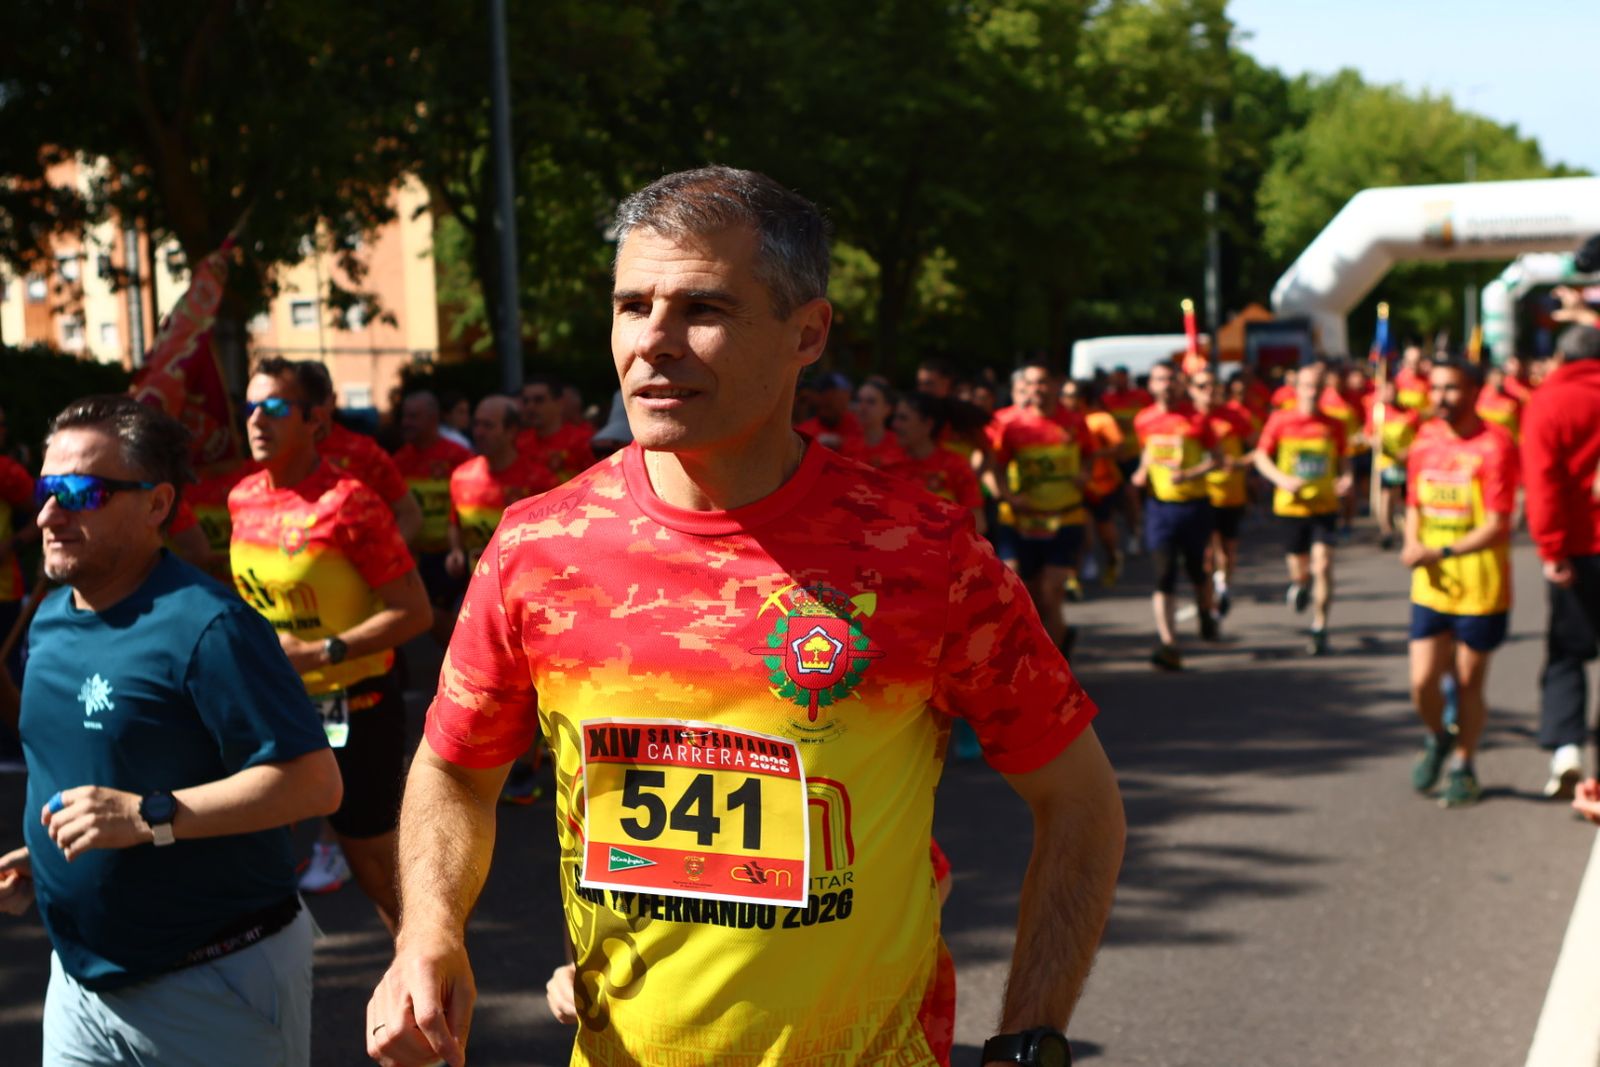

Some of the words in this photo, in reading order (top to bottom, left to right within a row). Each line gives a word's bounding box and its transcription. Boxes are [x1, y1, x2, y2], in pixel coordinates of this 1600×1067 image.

[528, 501, 570, 520] MKA
[588, 728, 640, 758] XIV
[647, 728, 683, 745] SAN
[701, 732, 792, 759] FERNANDO
[647, 744, 746, 767] CARRERA
[749, 753, 790, 774] 2026
[620, 769, 762, 850] 541
[638, 892, 776, 930] FERNANDO
[781, 888, 854, 929] 2026
